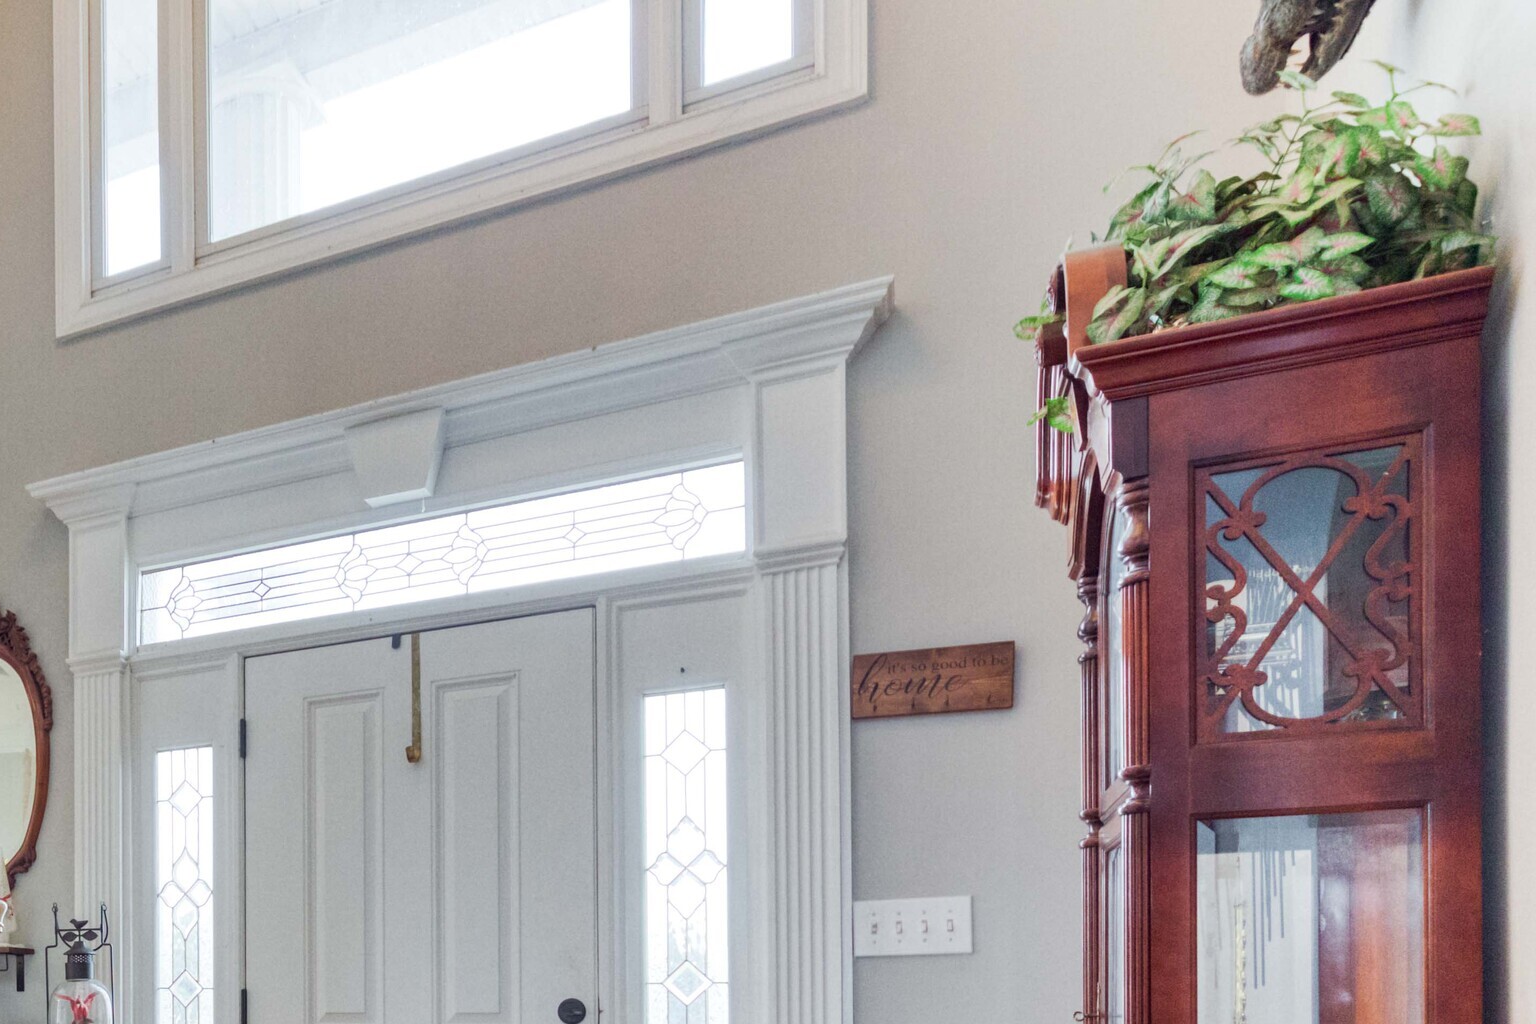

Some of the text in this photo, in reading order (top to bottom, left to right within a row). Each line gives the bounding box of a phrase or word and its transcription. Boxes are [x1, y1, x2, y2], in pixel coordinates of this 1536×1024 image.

[858, 653, 966, 704] home
[887, 654, 1009, 675] it's so good to be
